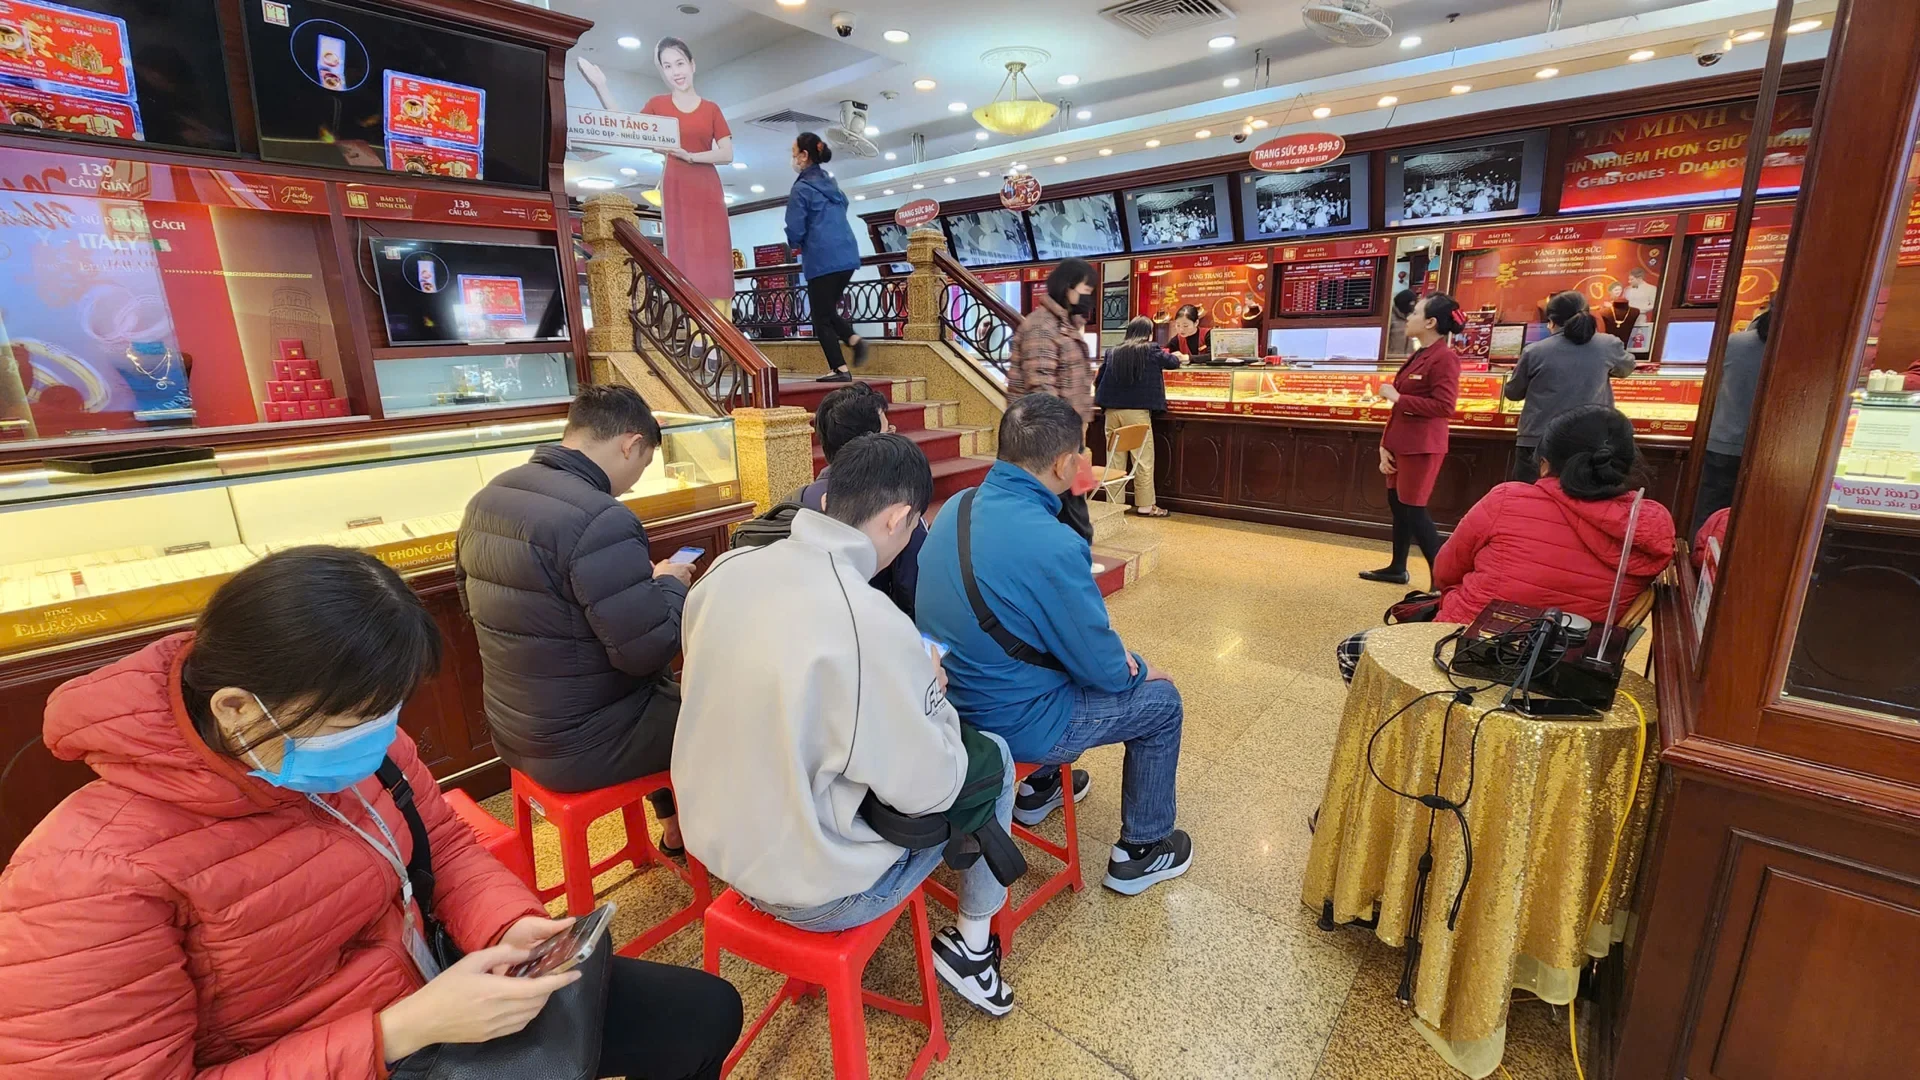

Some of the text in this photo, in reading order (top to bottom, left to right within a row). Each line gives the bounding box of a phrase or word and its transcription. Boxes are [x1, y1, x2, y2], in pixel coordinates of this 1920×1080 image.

[578, 112, 658, 132] LỐI LÊN TẦNG 2
[586, 127, 601, 136] SỨC
[602, 130, 615, 138] ĐẸP
[620, 131, 640, 141] NHIỀU
[642, 133, 657, 142] QUÀ
[657, 135, 676, 144] TẶNG
[1255, 148, 1280, 160] TRANG
[1281, 144, 1297, 157] SỨC
[1592, 151, 1650, 170] NHIỆM
[1654, 142, 1701, 160] HƠN
[1290, 157, 1304, 165] GOLD
[1304, 155, 1328, 164] JEWELRY
[78, 162, 114, 178] 139
[68, 175, 97, 190] CẦU
[100, 178, 133, 193] GIẤY
[395, 202, 412, 210] CHÂU
[453, 199, 470, 209] 139
[898, 208, 914, 220] TRANG
[914, 206, 925, 215] SỨC
[152, 218, 186, 231] CÁCH
[78, 232, 141, 251] ITALY
[1535, 245, 1602, 257] VÀNG TRANG SỨC
[1188, 272, 1203, 280] VÀNG
[389, 545, 432, 561] PHONG
[402, 557, 429, 568] PHONG
